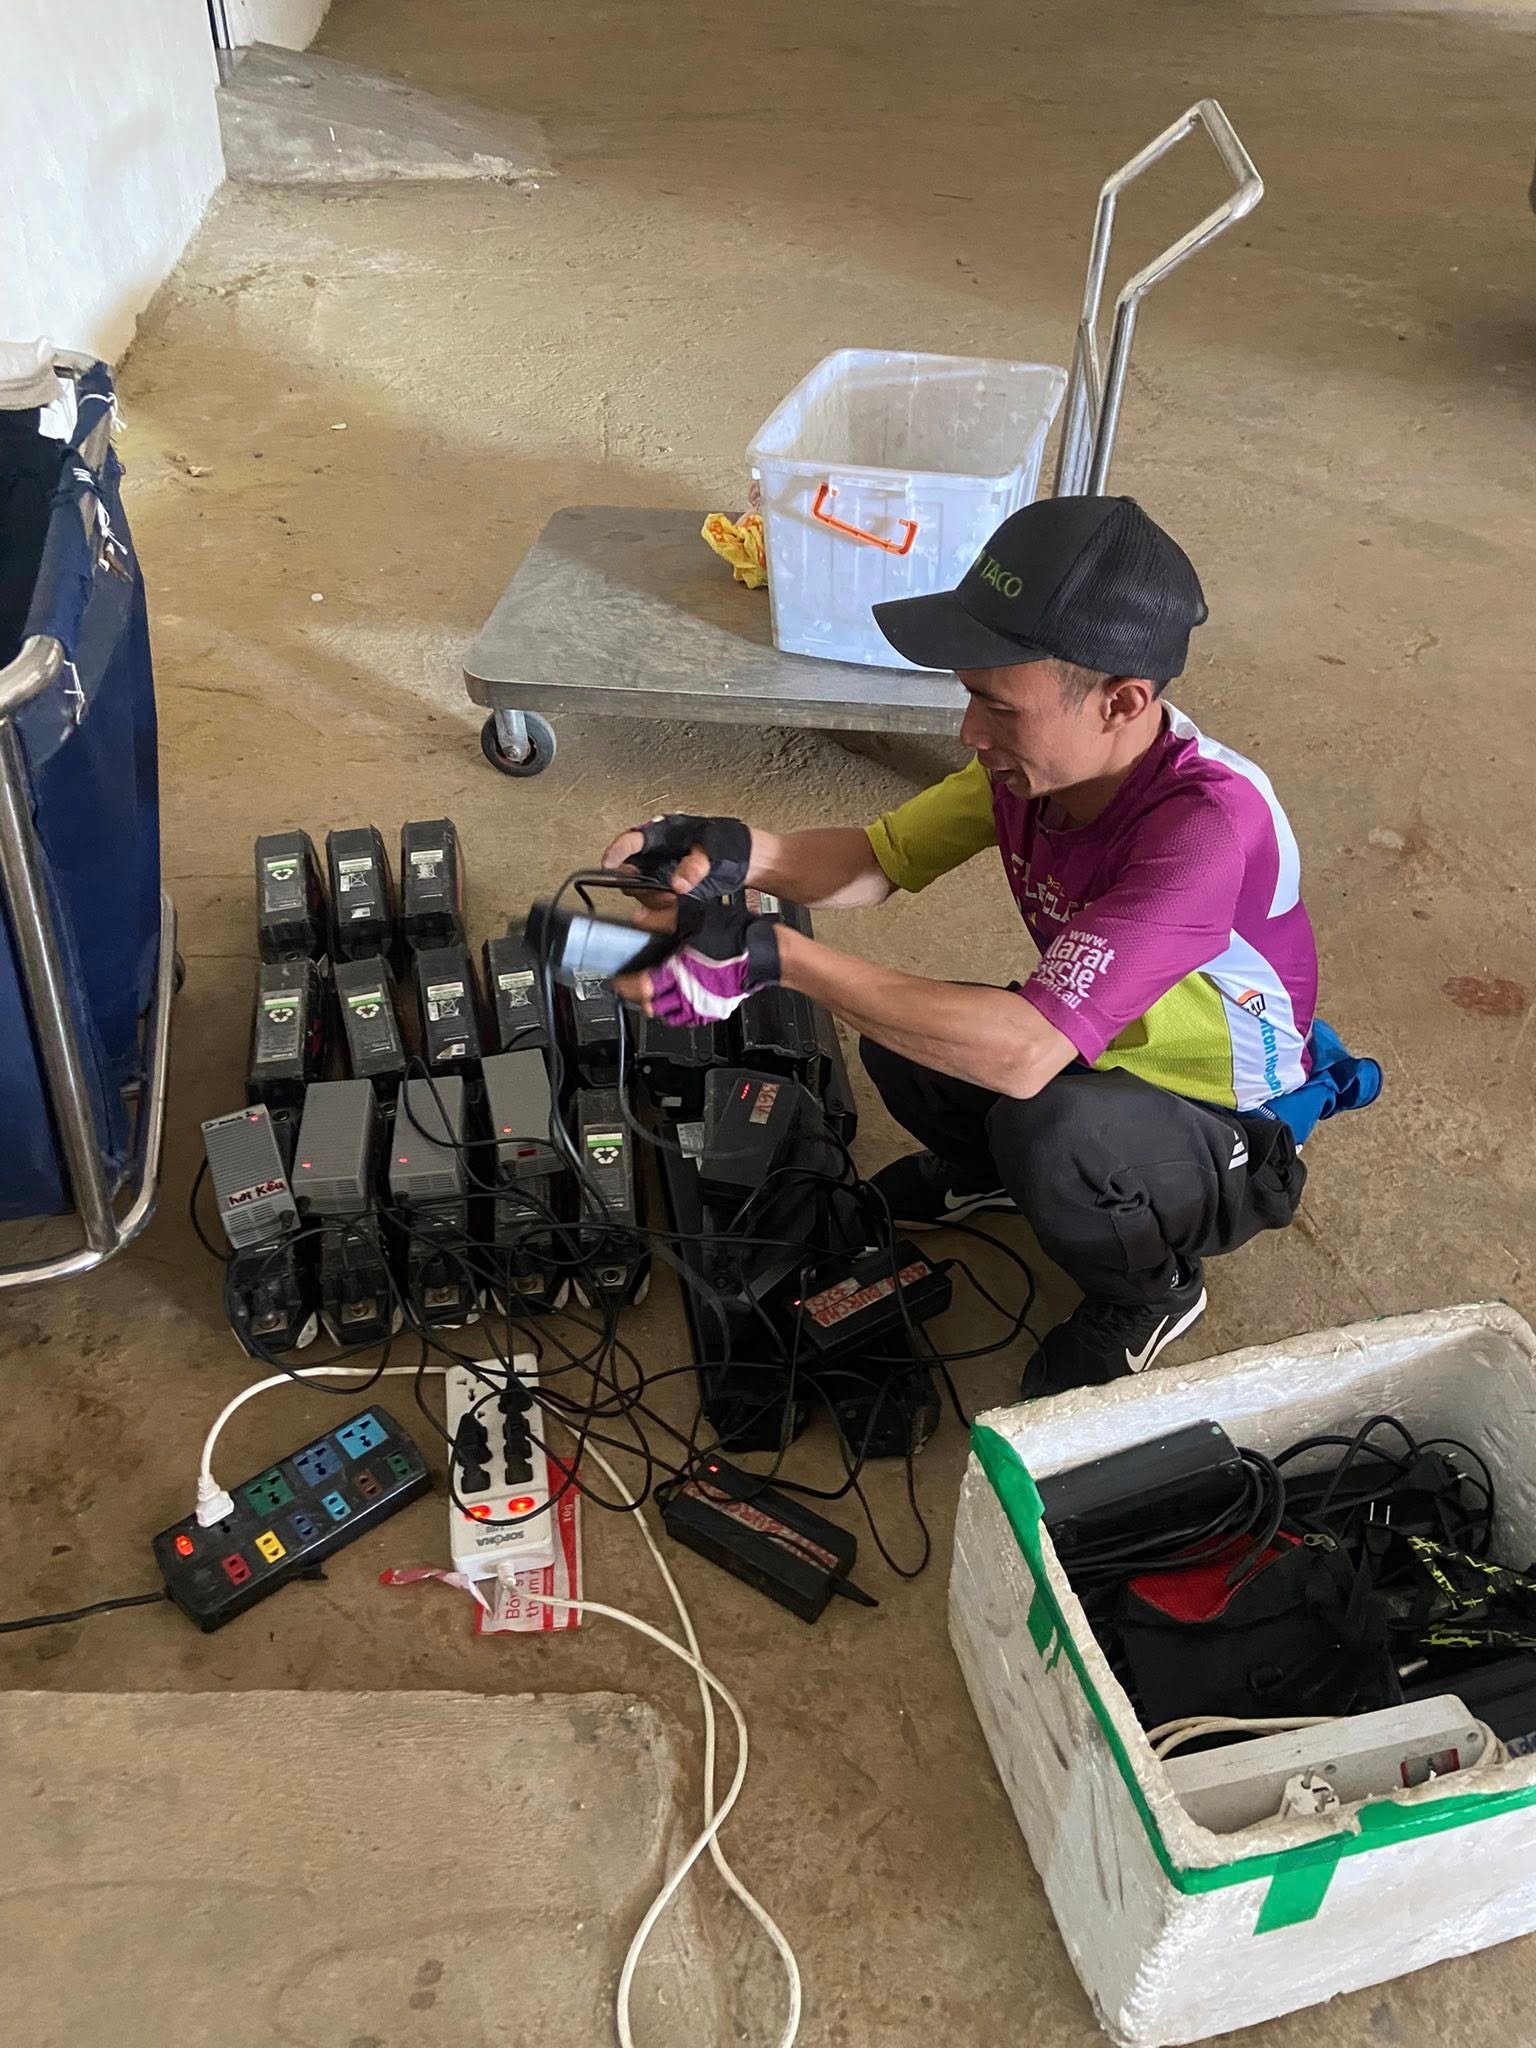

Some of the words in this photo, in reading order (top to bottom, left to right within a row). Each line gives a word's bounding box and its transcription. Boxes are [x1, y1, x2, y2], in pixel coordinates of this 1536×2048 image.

[981, 555, 1024, 598] TACO
[1069, 929, 1108, 950] www.
[526, 1577, 540, 1618] thm
